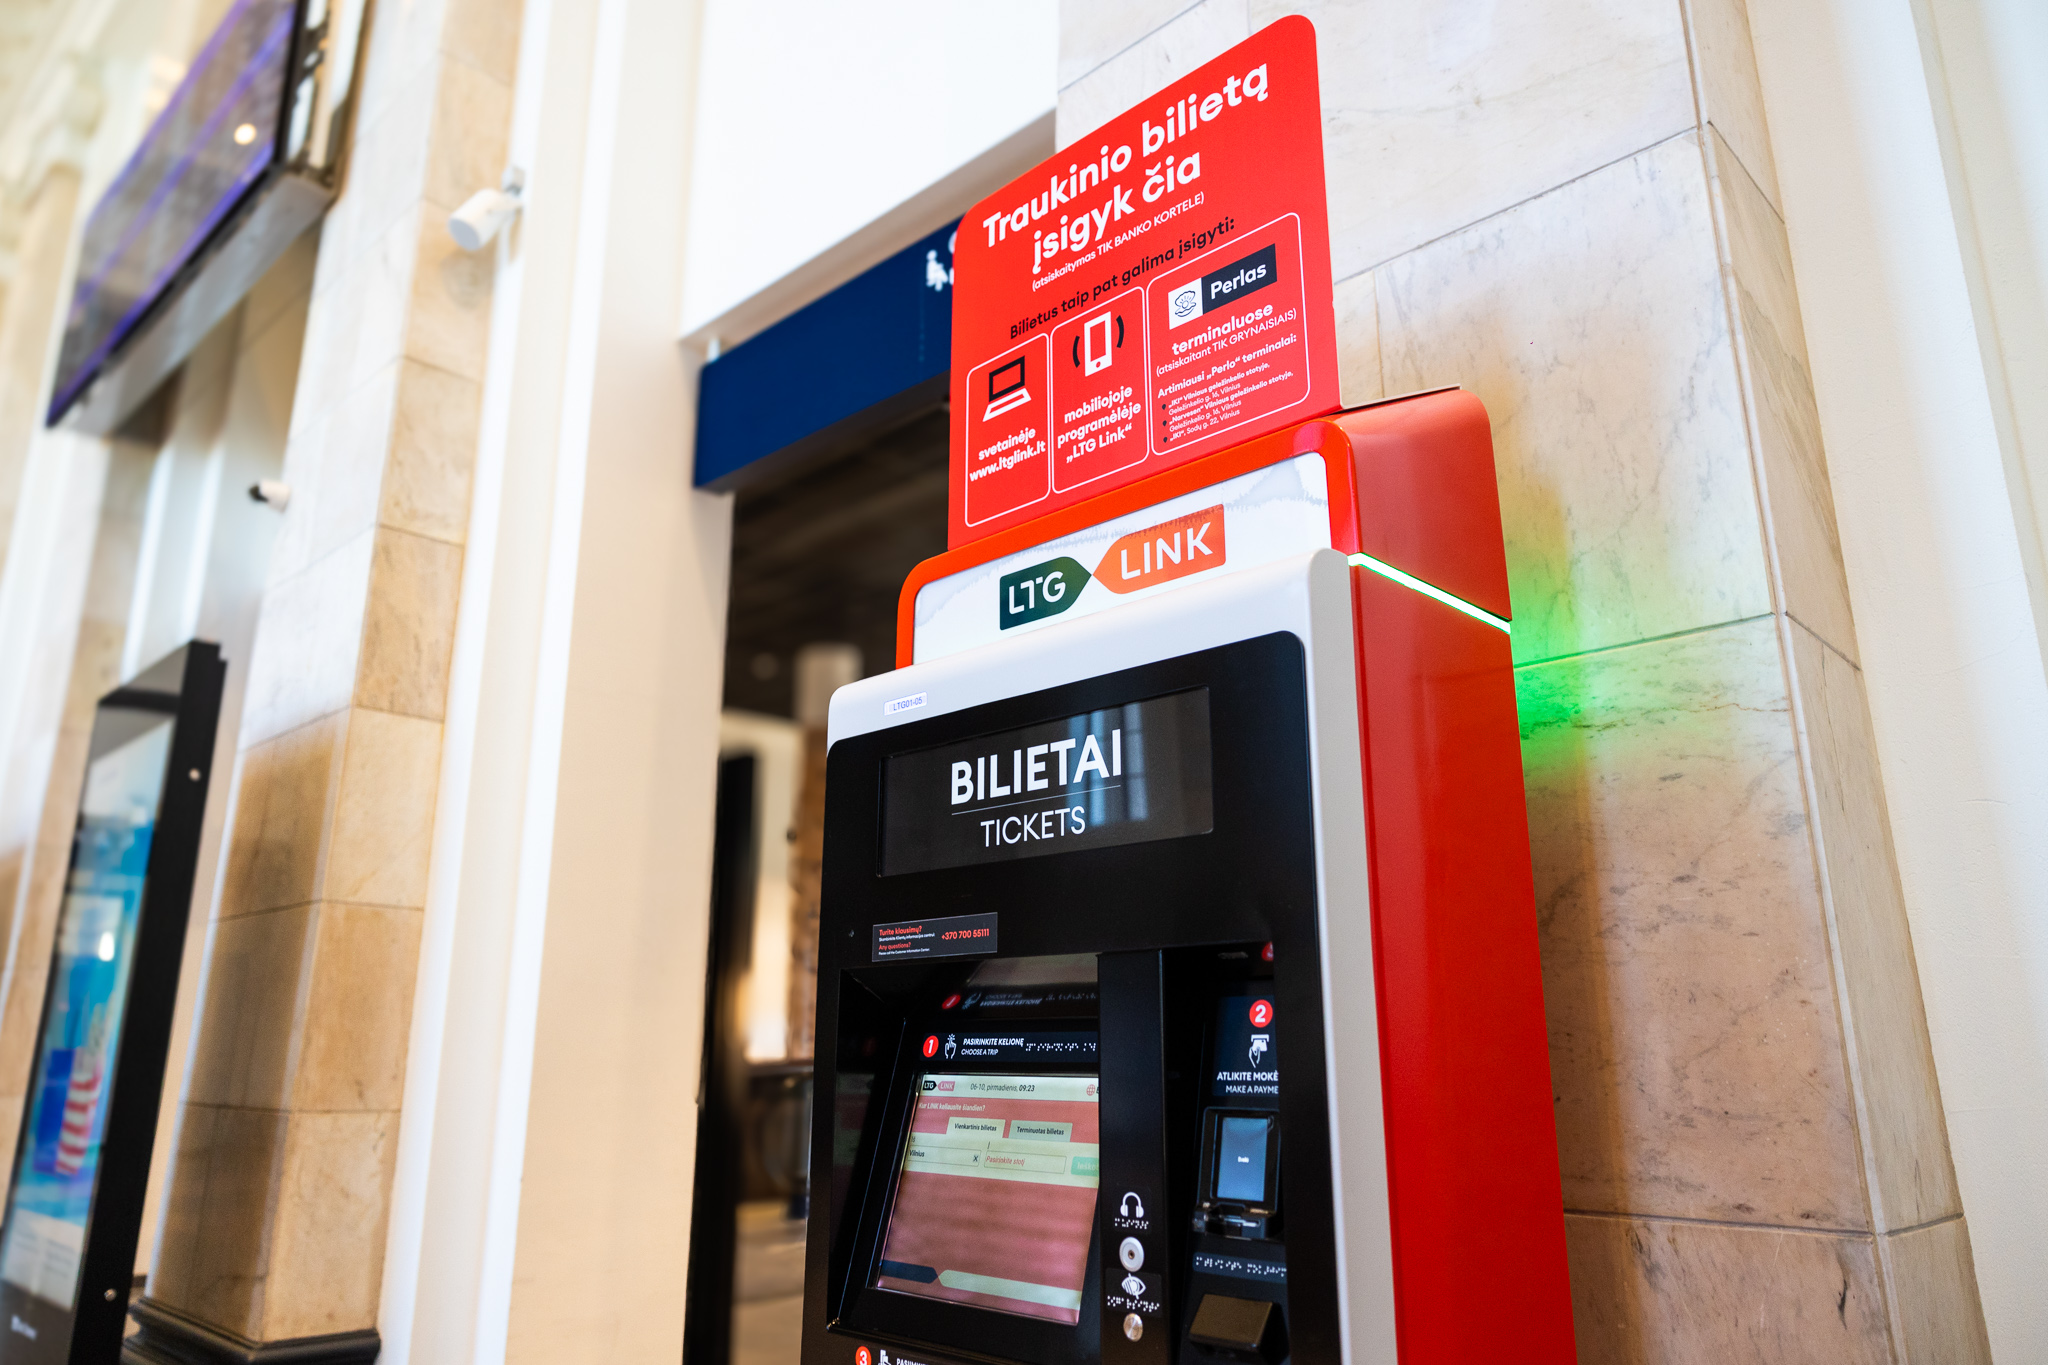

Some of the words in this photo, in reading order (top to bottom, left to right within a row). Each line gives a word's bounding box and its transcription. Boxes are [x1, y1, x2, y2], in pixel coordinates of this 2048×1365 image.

[983, 145, 1132, 247] Traukinio
[1142, 63, 1269, 157] bilietą
[1032, 185, 1135, 274] įsigyk
[1142, 152, 1201, 203] čia
[1032, 251, 1096, 292] (atsiskaitymas
[1097, 240, 1113, 256] TIK
[1114, 219, 1152, 248] BANKO
[1153, 191, 1205, 227] KORTELE)
[1010, 307, 1059, 339] Bilietus
[1060, 291, 1089, 312] taip
[1093, 275, 1118, 301] pat
[1122, 247, 1175, 286] galima
[1179, 216, 1235, 259] įsigyti:
[1210, 264, 1267, 299] Perlas
[1156, 348, 1211, 377] (atsiskaitant
[1212, 338, 1228, 352] TIK
[1229, 308, 1297, 344] GRYNAISIAIS)
[1171, 304, 1273, 355] terminaluose
[1157, 371, 1205, 398] Artimiausi
[1242, 333, 1297, 363] terminalai:
[1168, 396, 1204, 416] Geležinkelio
[1220, 382, 1241, 396] Vilnius
[1183, 387, 1208, 402] Vilniaus
[1208, 372, 1245, 393] geležinkelio
[1204, 394, 1230, 410] Vilniaus
[1230, 381, 1267, 402] geležinkelio
[1064, 385, 1133, 423] mobiliojoje
[1169, 413, 1205, 433] Geležinkelio
[1221, 399, 1242, 413] Vilnius
[1057, 402, 1141, 448] programėlėje
[1186, 423, 1203, 436] Sodų
[1220, 409, 1240, 421] Vilnius
[978, 427, 1036, 460] svetainėje
[1066, 438, 1096, 463] „LTG
[1099, 423, 1132, 448] Link“
[969, 441, 1046, 482] www.ltglink.lt
[1008, 571, 1066, 615] LTG
[1120, 521, 1214, 580] LINK
[893, 696, 923, 712] LTG01-05
[951, 729, 1121, 805] BILIETAI
[980, 805, 1085, 847] TICKETS
[941, 932, 957, 940] +370
[958, 930, 971, 938] 700
[972, 928, 989, 937] 55111
[1255, 1004, 1266, 1023] 2
[927, 1039, 934, 1054] 1
[963, 1037, 997, 1046] PASIRINKITE
[998, 1037, 1024, 1047] KELIONĘ
[923, 1081, 934, 1089] LTG
[1019, 1084, 1035, 1092] 09:23
[1216, 1071, 1252, 1081] ATLIKITE
[1225, 1085, 1246, 1094] MAKE
[1246, 1085, 1253, 1094] A
[979, 1124, 997, 1132] bilietas
[1016, 1126, 1045, 1135] Terminuotas
[909, 1149, 925, 1158] Vilnius
[860, 1350, 868, 1365] 3
